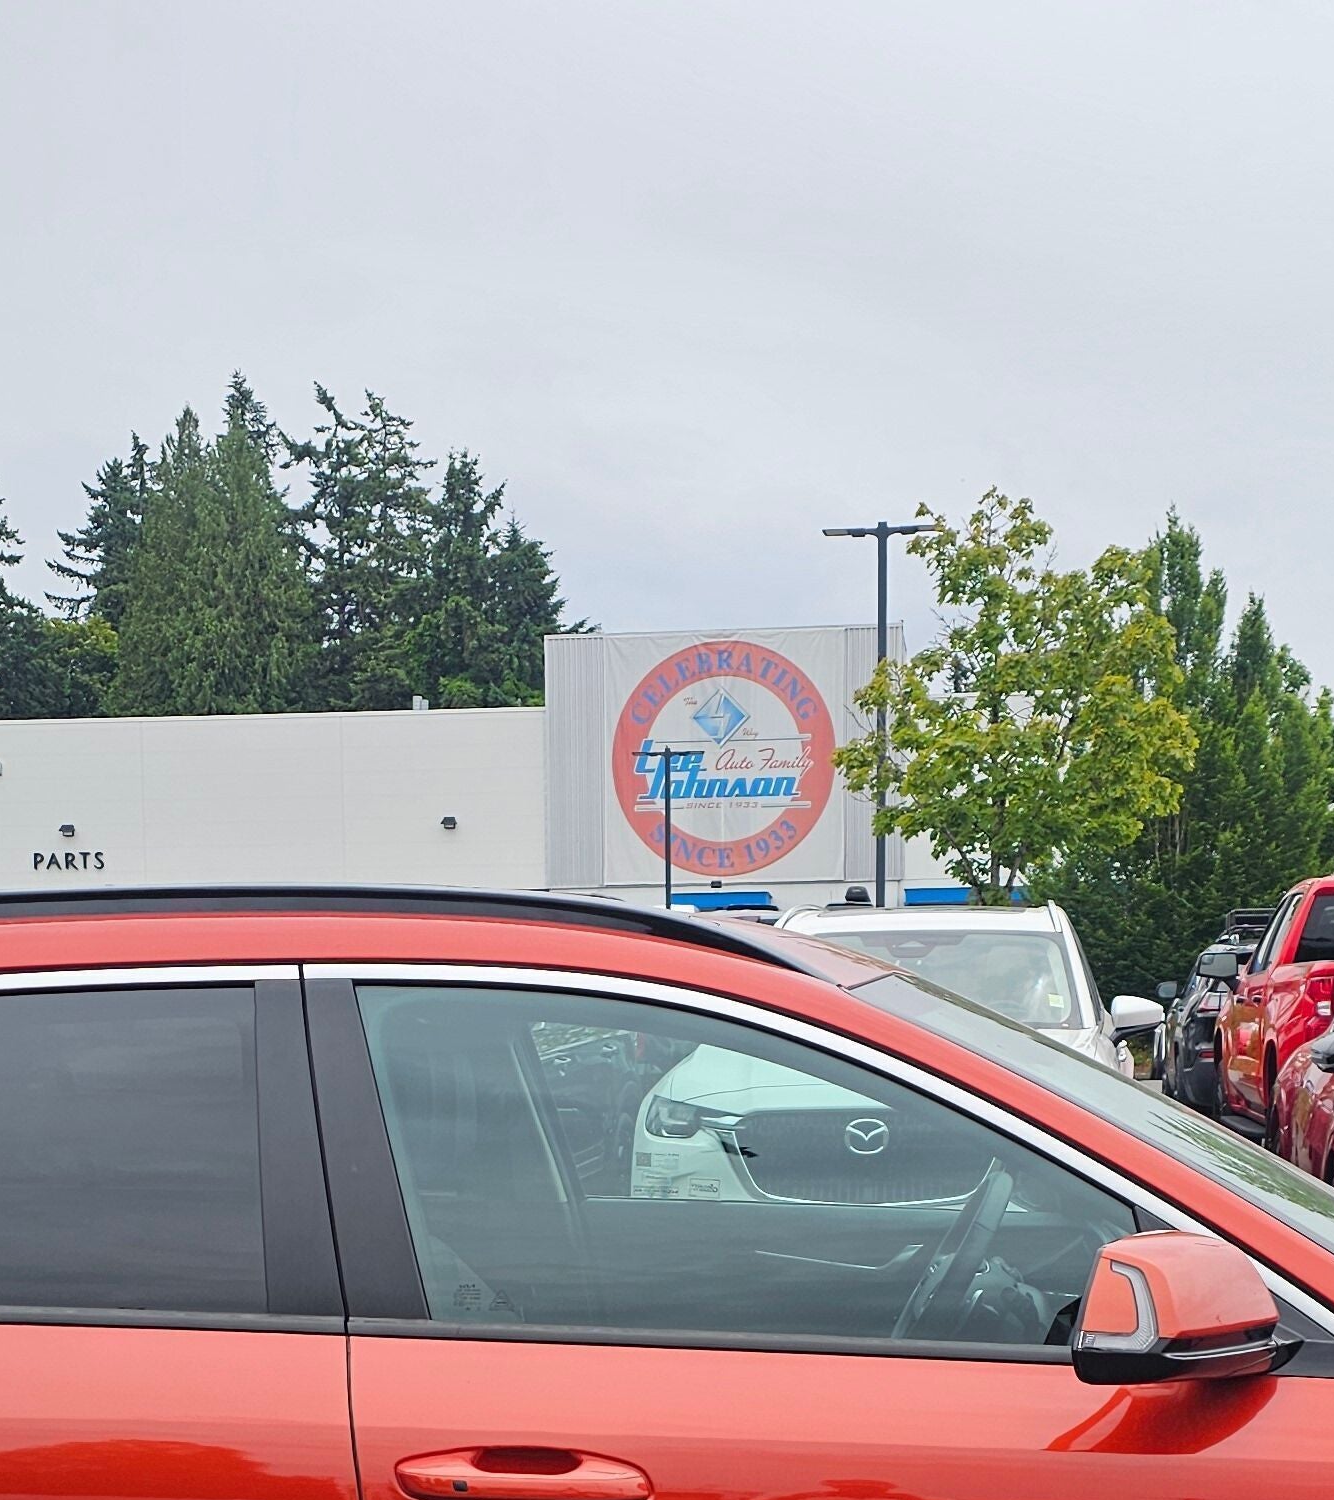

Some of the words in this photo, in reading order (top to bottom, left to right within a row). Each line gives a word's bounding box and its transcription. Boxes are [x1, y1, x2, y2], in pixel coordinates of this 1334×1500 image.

[630, 649, 818, 725] CELEBRATING
[634, 739, 707, 773] Lee
[715, 748, 754, 771] Auto
[758, 746, 814, 777] Family
[639, 754, 798, 799] Johnson
[686, 801, 723, 809] SINCE
[729, 801, 759, 809] 1933
[33, 851, 105, 871] PARTS
[649, 823, 735, 869] SNCE
[744, 819, 798, 865] 1933
